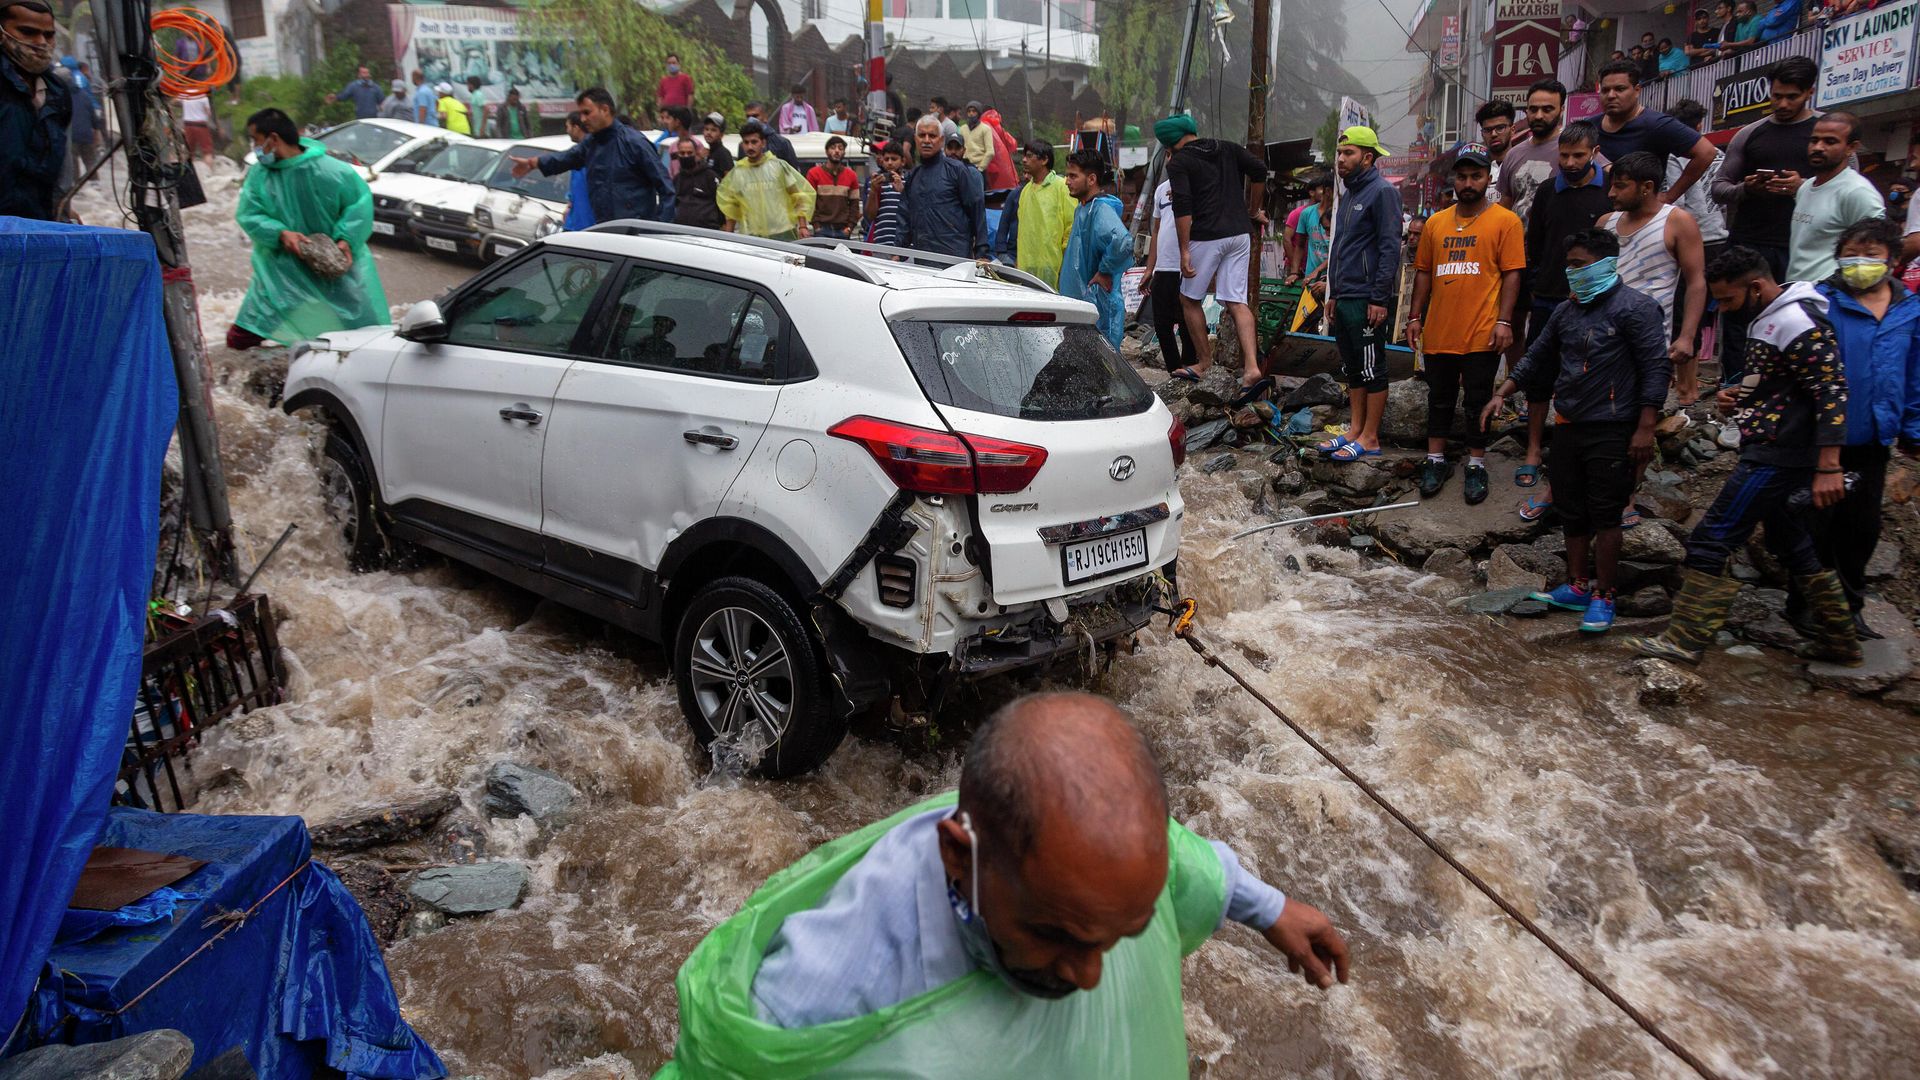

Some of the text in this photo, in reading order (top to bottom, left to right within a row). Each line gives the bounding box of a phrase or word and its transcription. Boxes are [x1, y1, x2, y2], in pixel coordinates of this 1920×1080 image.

[1498, 3, 1559, 17] AAKARSH
[1824, 3, 1918, 51] SKY LAUNDRY
[1836, 38, 1893, 66] SERVICE
[1827, 61, 1903, 86] Same Day Delivery
[1493, 94, 1529, 103] RESTAU
[1823, 89, 1834, 101] ALL
[1836, 86, 1853, 98] KINDS
[1854, 84, 1865, 95] OF
[1458, 143, 1488, 157] VANS
[1443, 236, 1477, 248] STRIVE
[1448, 250, 1466, 261] FOR
[1436, 262, 1481, 277] REATNESS.
[990, 503, 1039, 512] CRETA
[1075, 535, 1142, 571] RJ19CH1550
